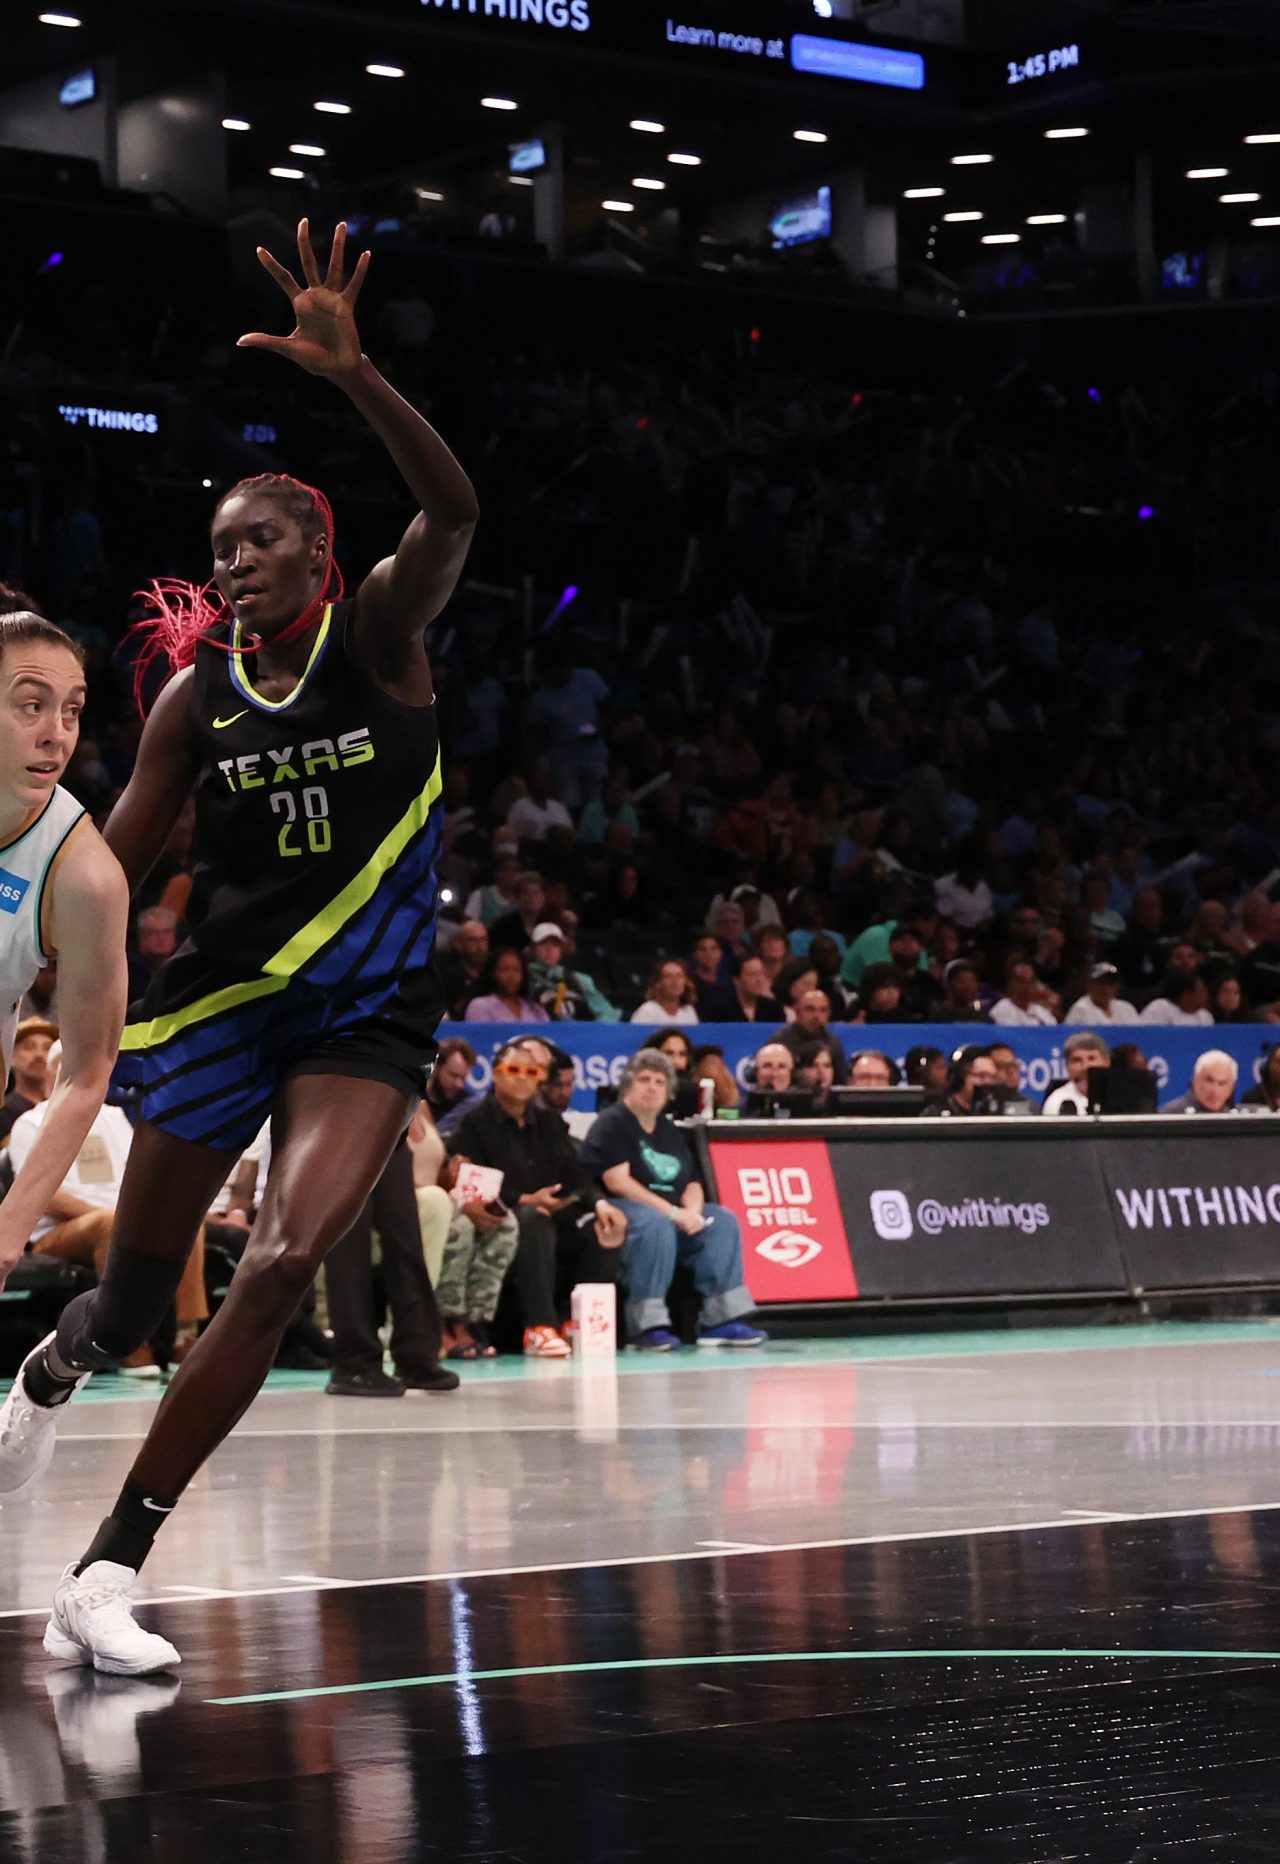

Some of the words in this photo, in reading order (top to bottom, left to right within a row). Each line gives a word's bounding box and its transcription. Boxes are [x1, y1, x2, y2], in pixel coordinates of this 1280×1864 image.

[421, 0, 590, 32] HINGS
[666, 18, 716, 47] Learn
[718, 32, 764, 56] more
[766, 38, 785, 59] at
[1007, 53, 1046, 85] 1:45
[1048, 43, 1080, 73] PM
[217, 727, 375, 793] TEXAS
[269, 785, 331, 858] 20
[737, 1167, 813, 1207] BIO
[746, 1207, 818, 1227] STEEL
[917, 1196, 1051, 1235] @withings
